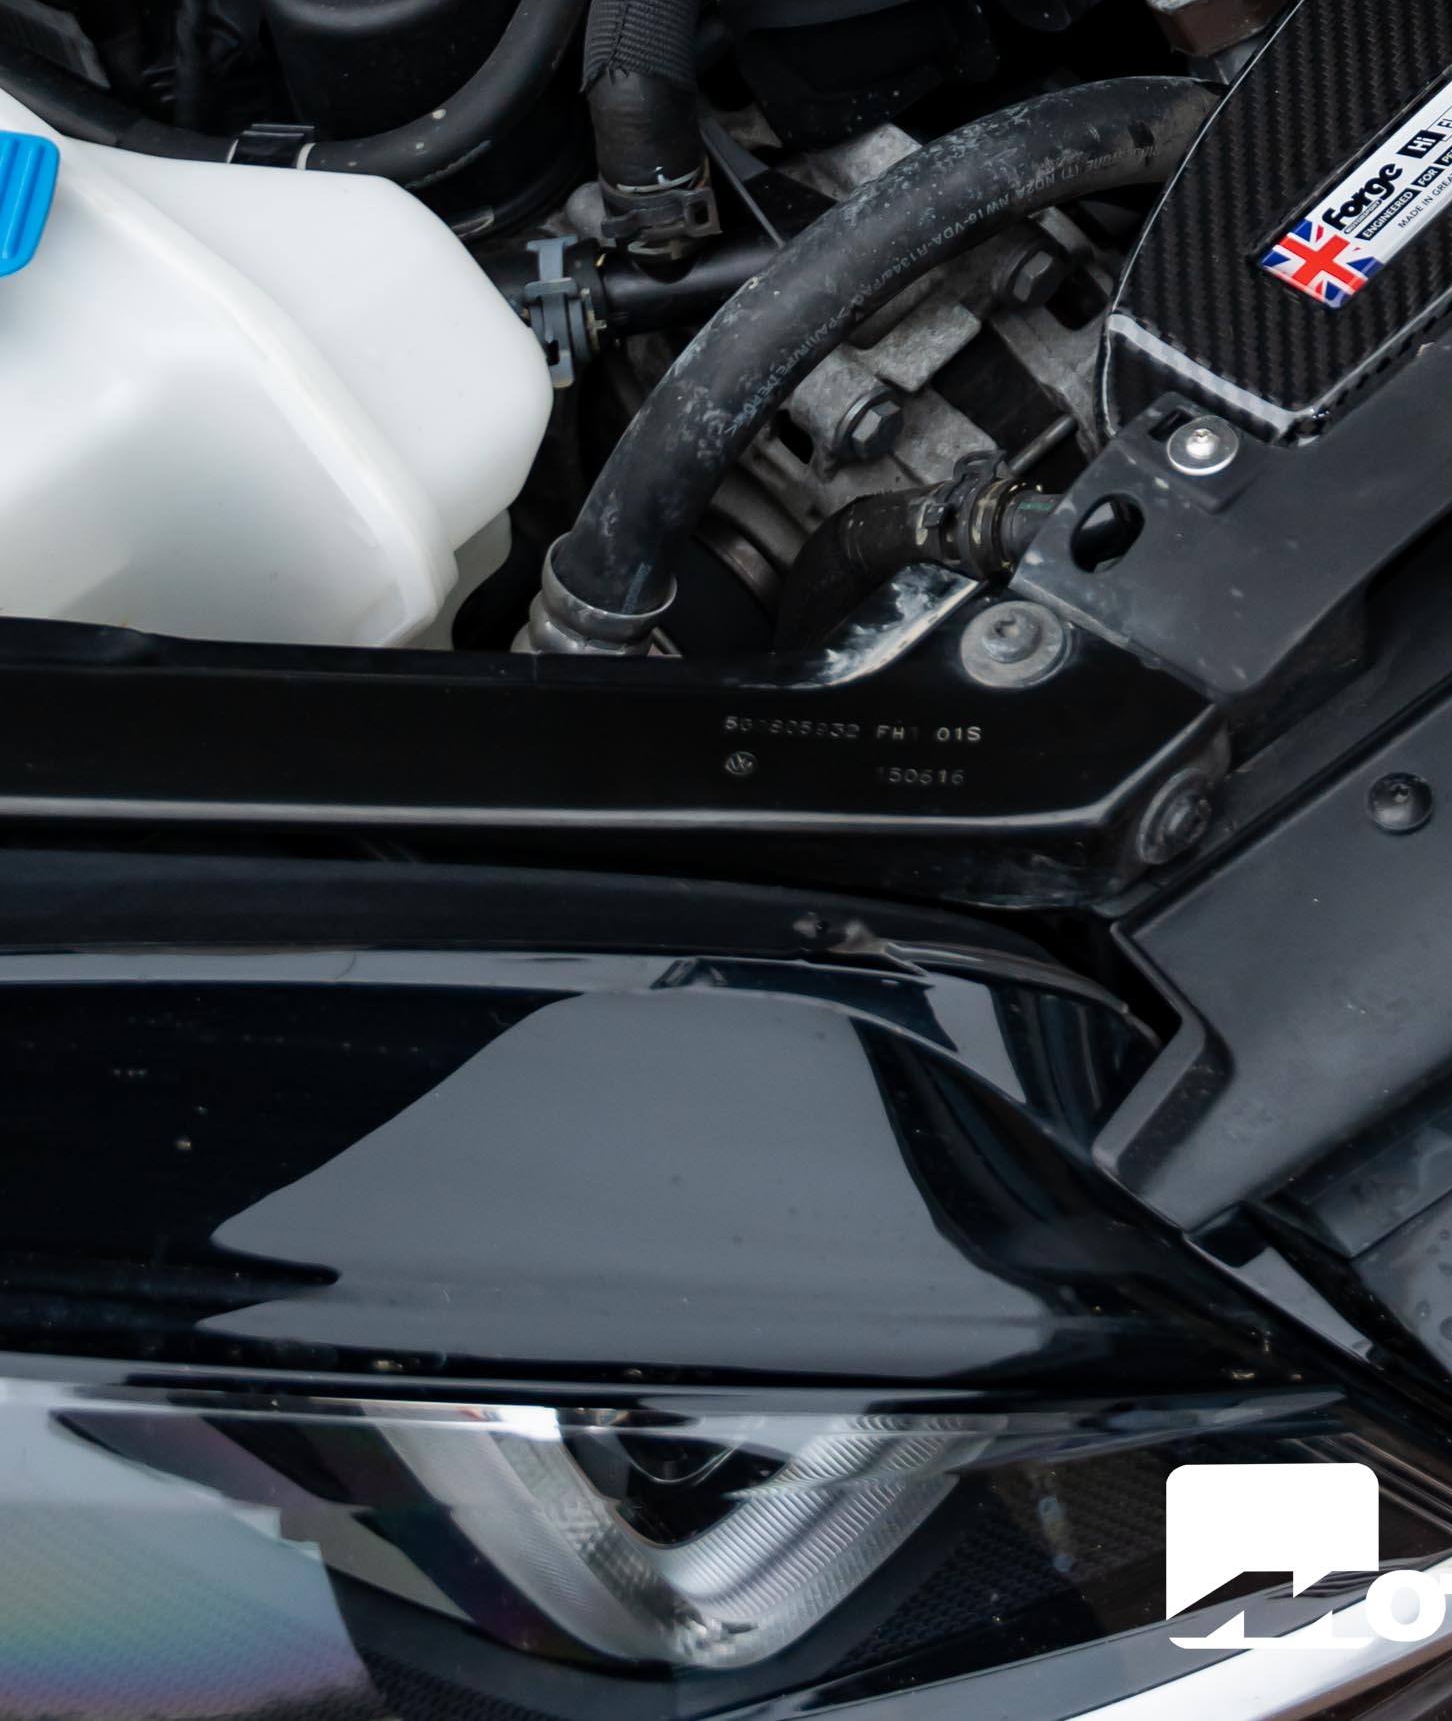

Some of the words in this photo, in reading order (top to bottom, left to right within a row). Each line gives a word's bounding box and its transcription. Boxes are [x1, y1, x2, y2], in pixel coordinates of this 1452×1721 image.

[1408, 136, 1437, 152] Hi
[1363, 191, 1414, 238] ENGINEERED
[1417, 168, 1438, 188] FOR
[1398, 205, 1424, 228] MADE
[1421, 195, 1434, 207] IN
